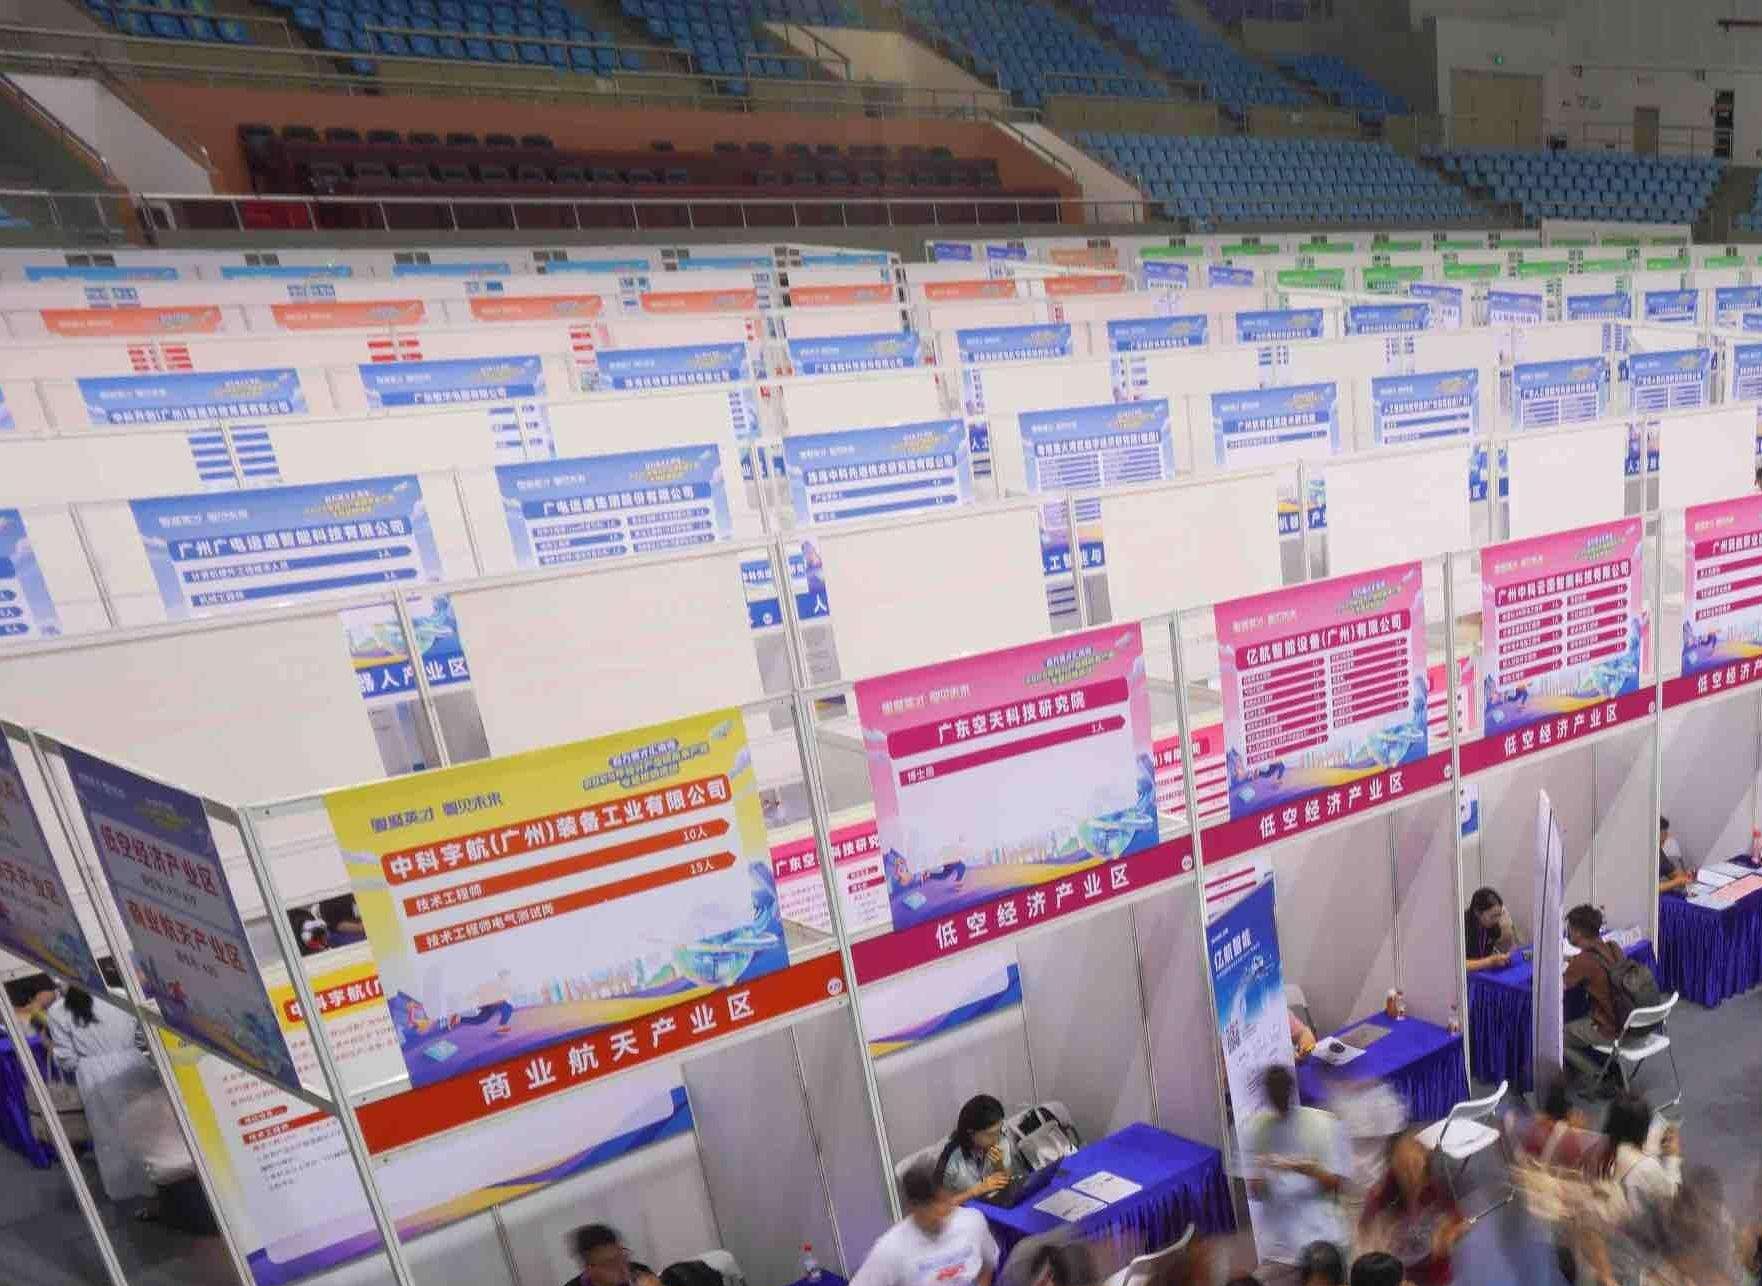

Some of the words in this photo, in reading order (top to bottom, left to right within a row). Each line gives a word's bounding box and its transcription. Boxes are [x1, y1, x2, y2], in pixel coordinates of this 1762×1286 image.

[937, 690, 1087, 746] 广东空天科技研究院
[1503, 702, 1619, 757] 低空经济产业区
[390, 778, 729, 881] 中科宇航(广州)装备工业有限公司
[1258, 770, 1406, 832] 低空经济产业区
[683, 825, 708, 843] 10人
[933, 861, 1131, 951] 低空经济产业区
[479, 990, 757, 1107] 商业航天产业区
